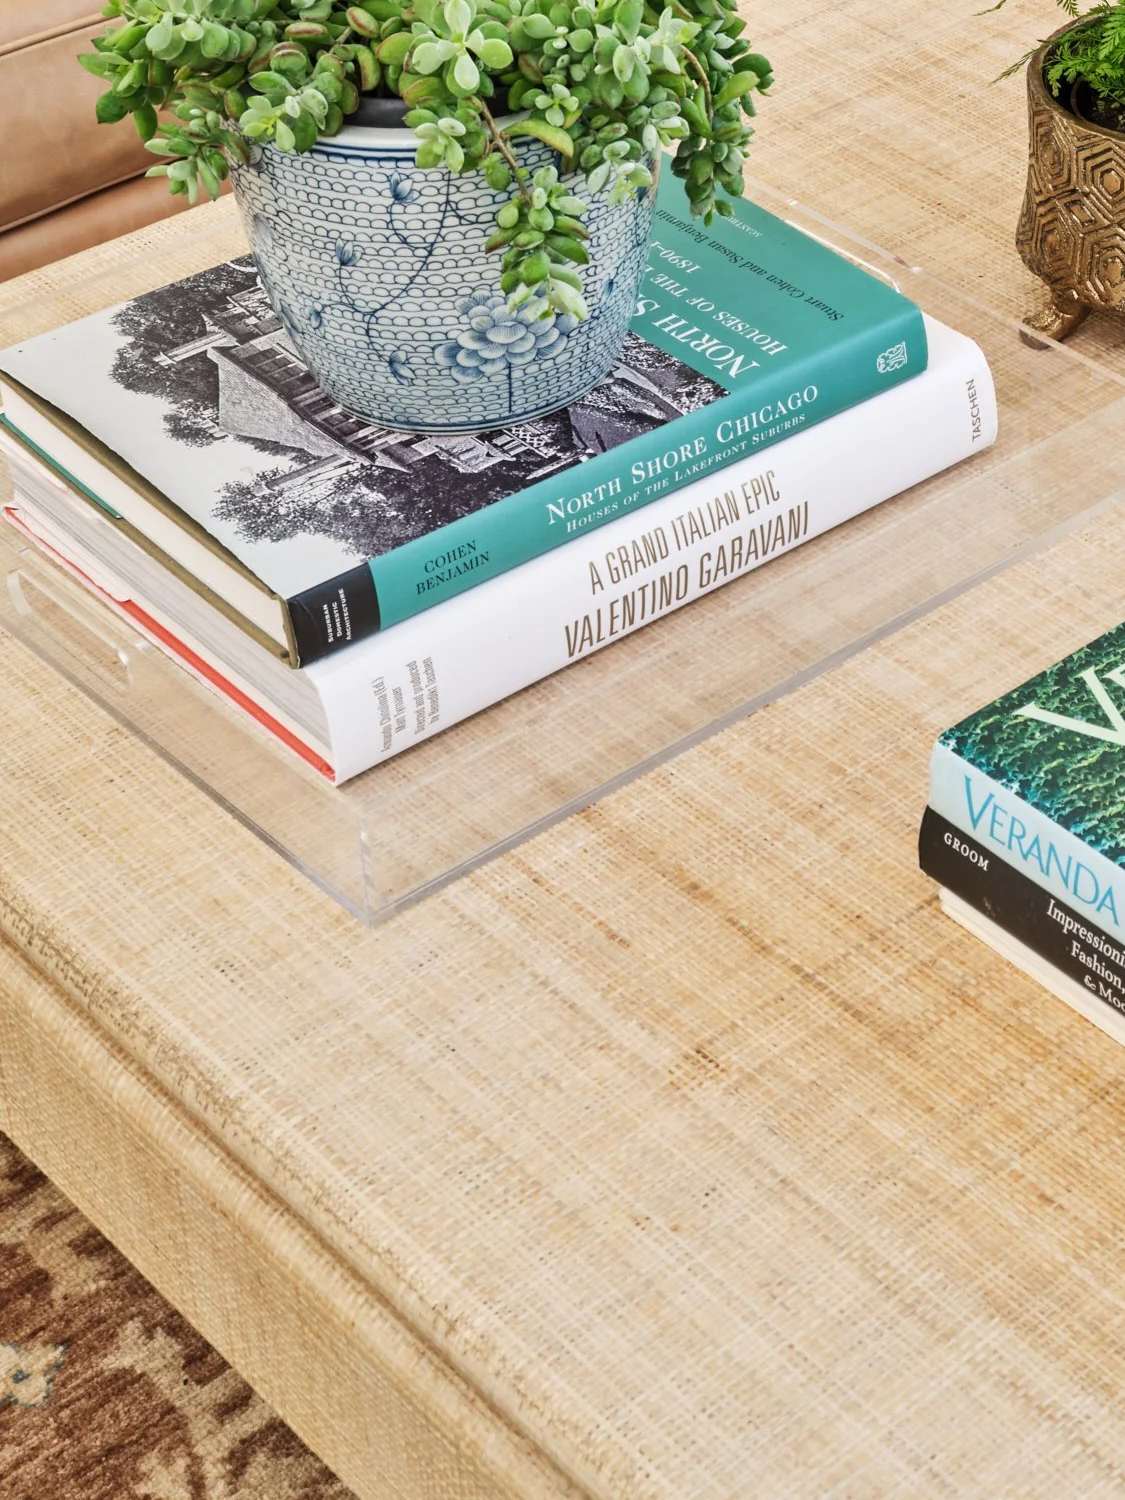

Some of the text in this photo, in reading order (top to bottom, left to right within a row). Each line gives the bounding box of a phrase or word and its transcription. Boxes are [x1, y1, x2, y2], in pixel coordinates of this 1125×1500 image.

[648, 272, 688, 298] THE
[653, 208, 844, 321] Stuart Cohen and Susan Benjamin
[685, 294, 714, 312] OF
[649, 311, 760, 378] NORTH
[710, 310, 787, 355] HOUSES
[965, 378, 982, 443] TASCHEN
[545, 384, 819, 526] NORTH SHORE CHICAGO
[565, 412, 807, 534] HOUSES OF THE LAKEFRONT SUBURBS
[587, 469, 781, 596] A GRAND ITALIAN EPIC
[415, 551, 492, 596] BENJAMIN
[423, 539, 478, 575] COHEN
[563, 501, 810, 659] VALENTINO GARAVANI
[323, 604, 334, 643] SUBURBAN
[332, 602, 342, 637] DOMESTIC
[338, 588, 352, 640] ARCHITECTURE
[371, 675, 387, 695] (Ed.)
[405, 659, 424, 695] produced
[421, 656, 436, 687] Taschen
[943, 832, 990, 873] GROOM
[964, 774, 1120, 928] VERANDA
[1083, 974, 1097, 991] &
